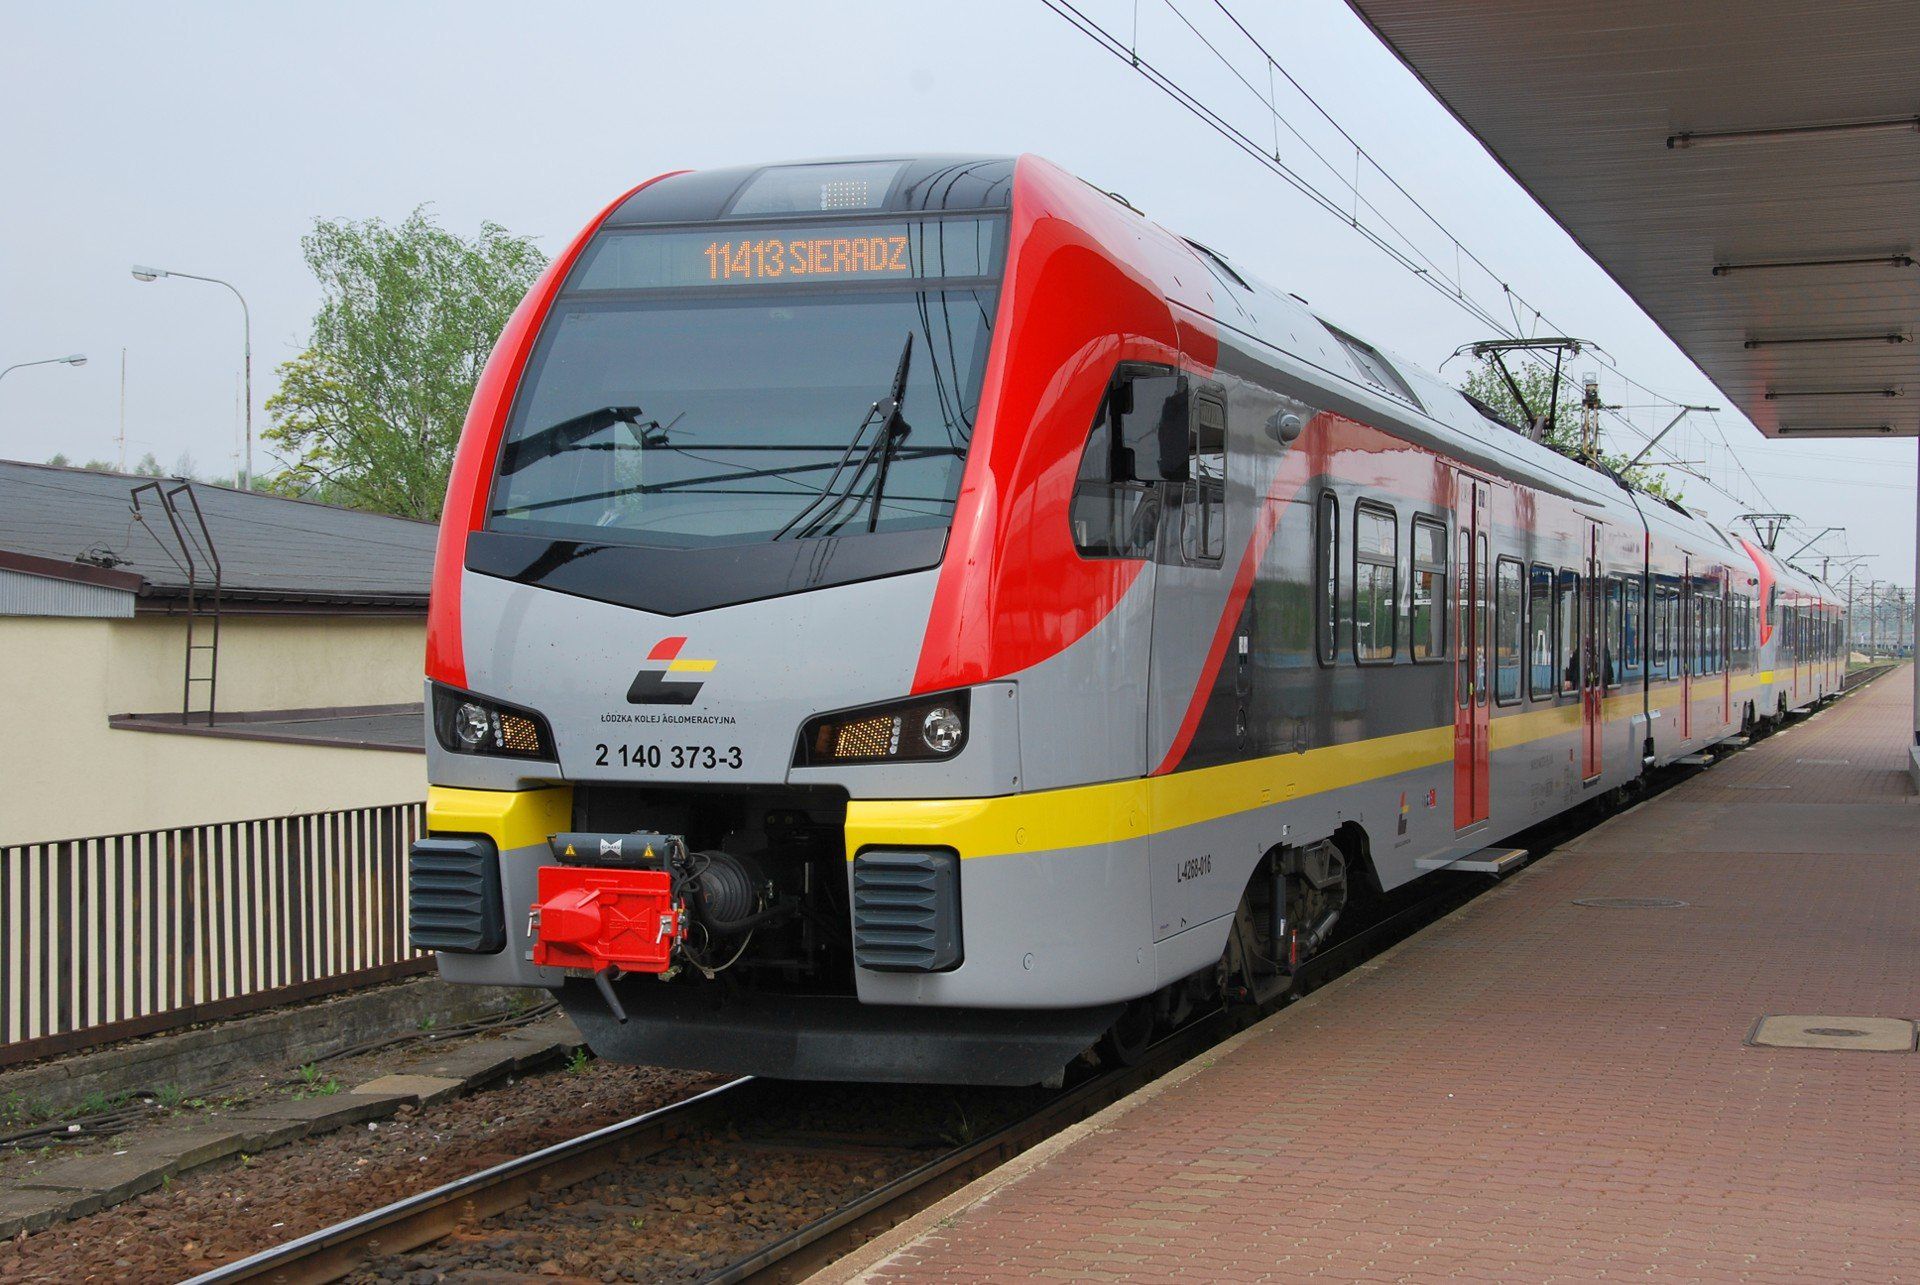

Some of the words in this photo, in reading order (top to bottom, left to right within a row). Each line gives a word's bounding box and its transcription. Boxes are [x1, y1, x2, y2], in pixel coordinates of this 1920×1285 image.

[704, 239, 785, 280] 11413
[789, 236, 907, 275] SIERADZ
[600, 712, 633, 723] ŁÓDZKA
[634, 714, 661, 724] KOLEJ
[662, 715, 737, 725] AGLOMERACYJNA
[595, 743, 609, 767] 2
[618, 744, 661, 769] 140
[670, 745, 743, 770] 373-3
[1177, 853, 1212, 883] L-4268-016
